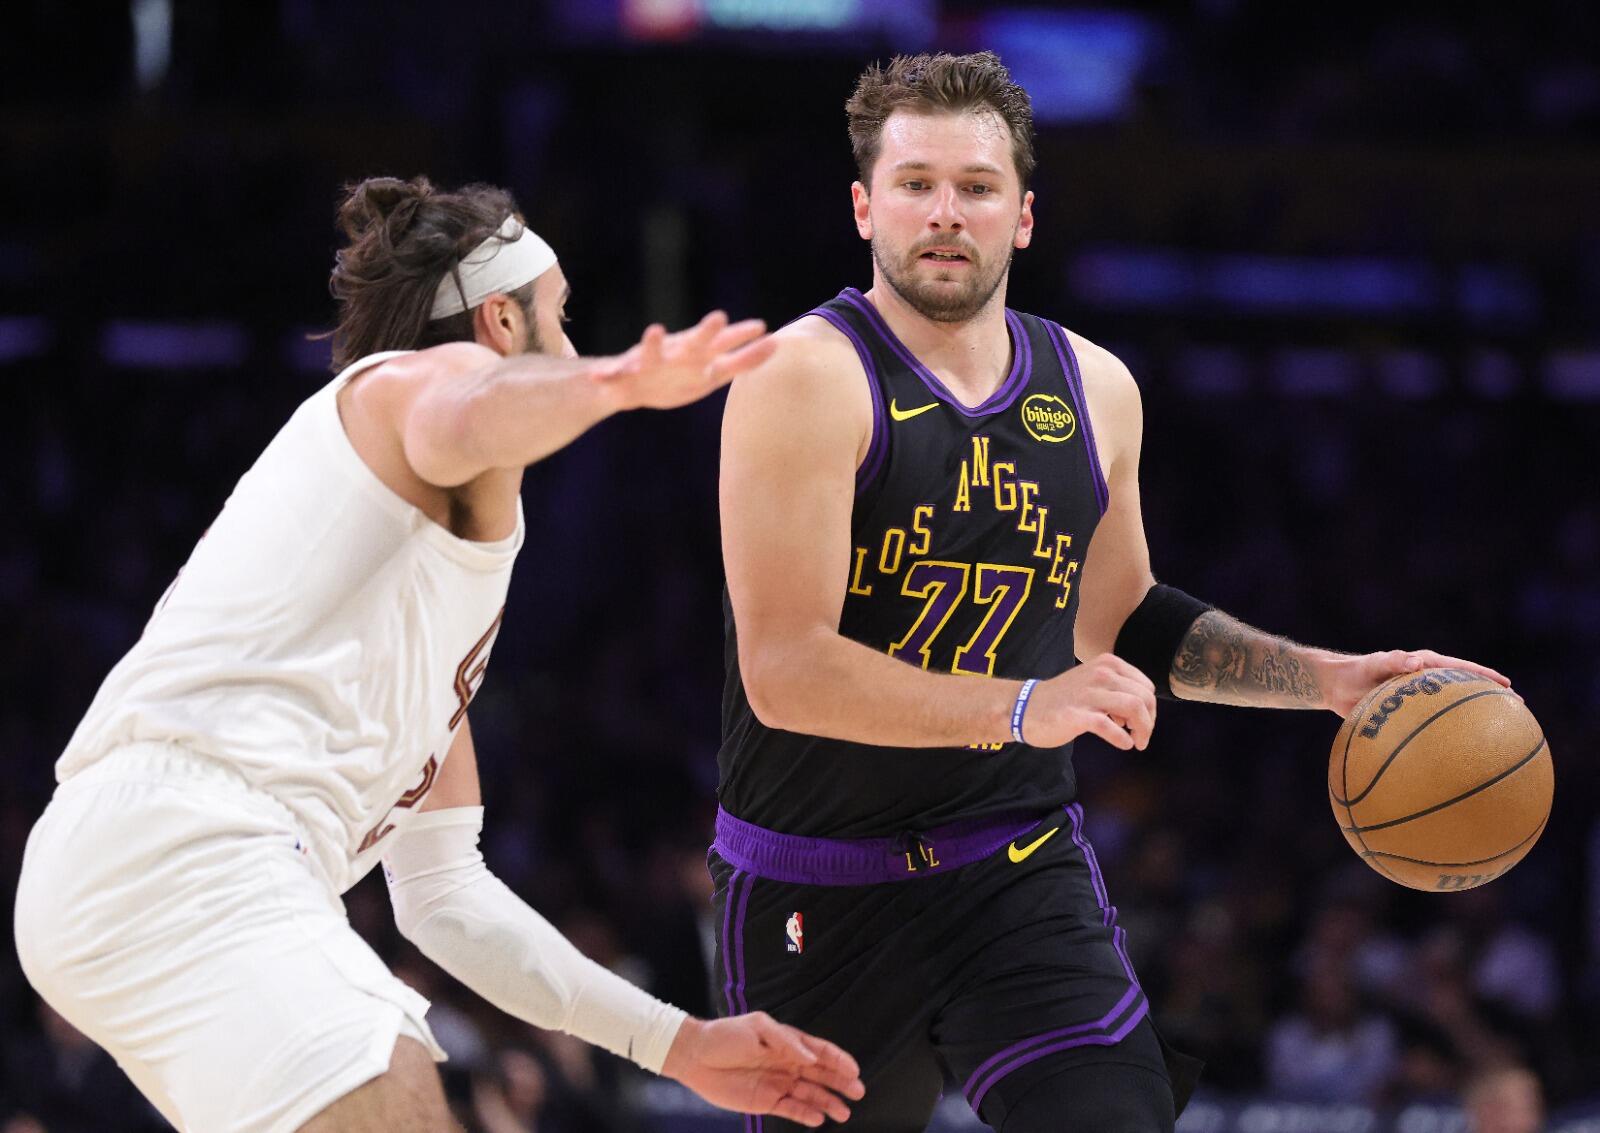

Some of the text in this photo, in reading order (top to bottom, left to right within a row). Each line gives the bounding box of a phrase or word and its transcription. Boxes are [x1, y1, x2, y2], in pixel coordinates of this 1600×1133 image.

[1026, 406, 1071, 428] bibigo
[849, 434, 1078, 610] LOS ANGELES
[888, 559, 1036, 678] 77
